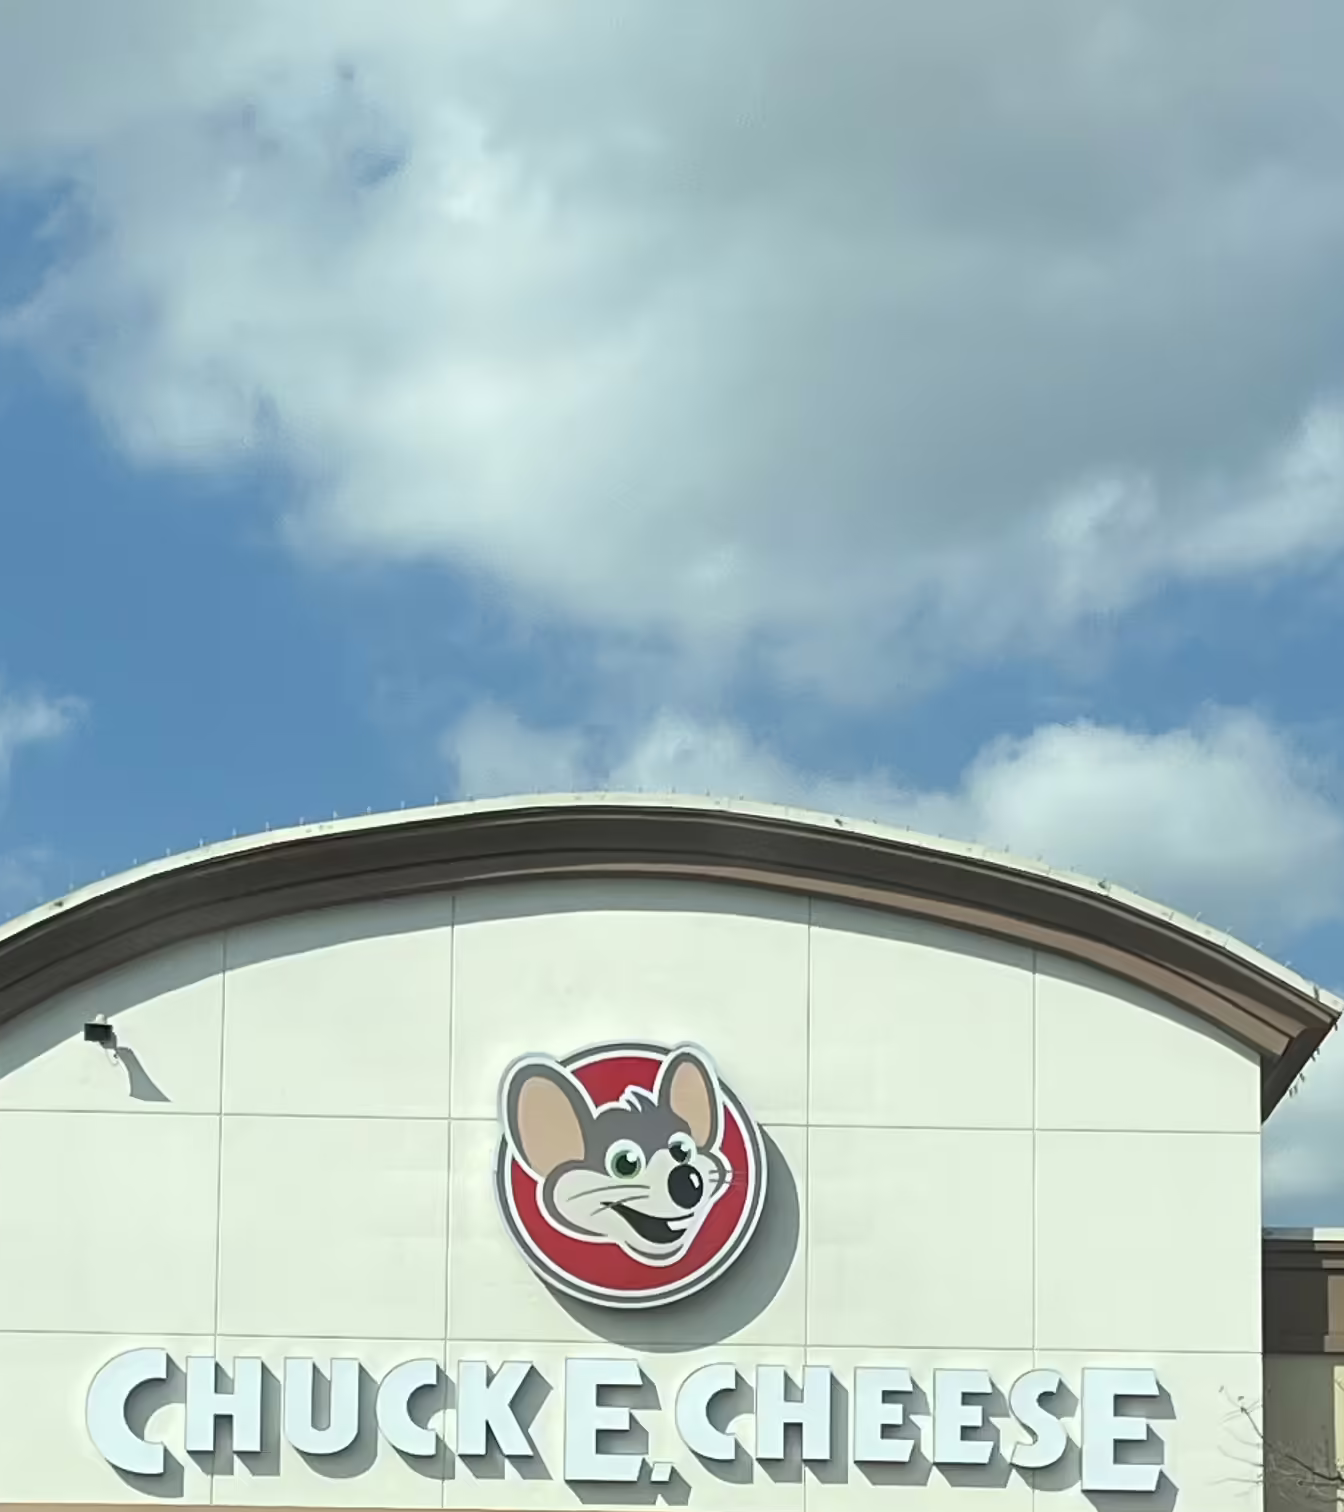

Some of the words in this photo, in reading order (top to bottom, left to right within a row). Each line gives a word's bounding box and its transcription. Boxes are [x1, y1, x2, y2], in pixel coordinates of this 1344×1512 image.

[85, 1347, 536, 1475] CHUCK
[564, 1357, 674, 1483] E.
[675, 1362, 1162, 1492] CHEESE
